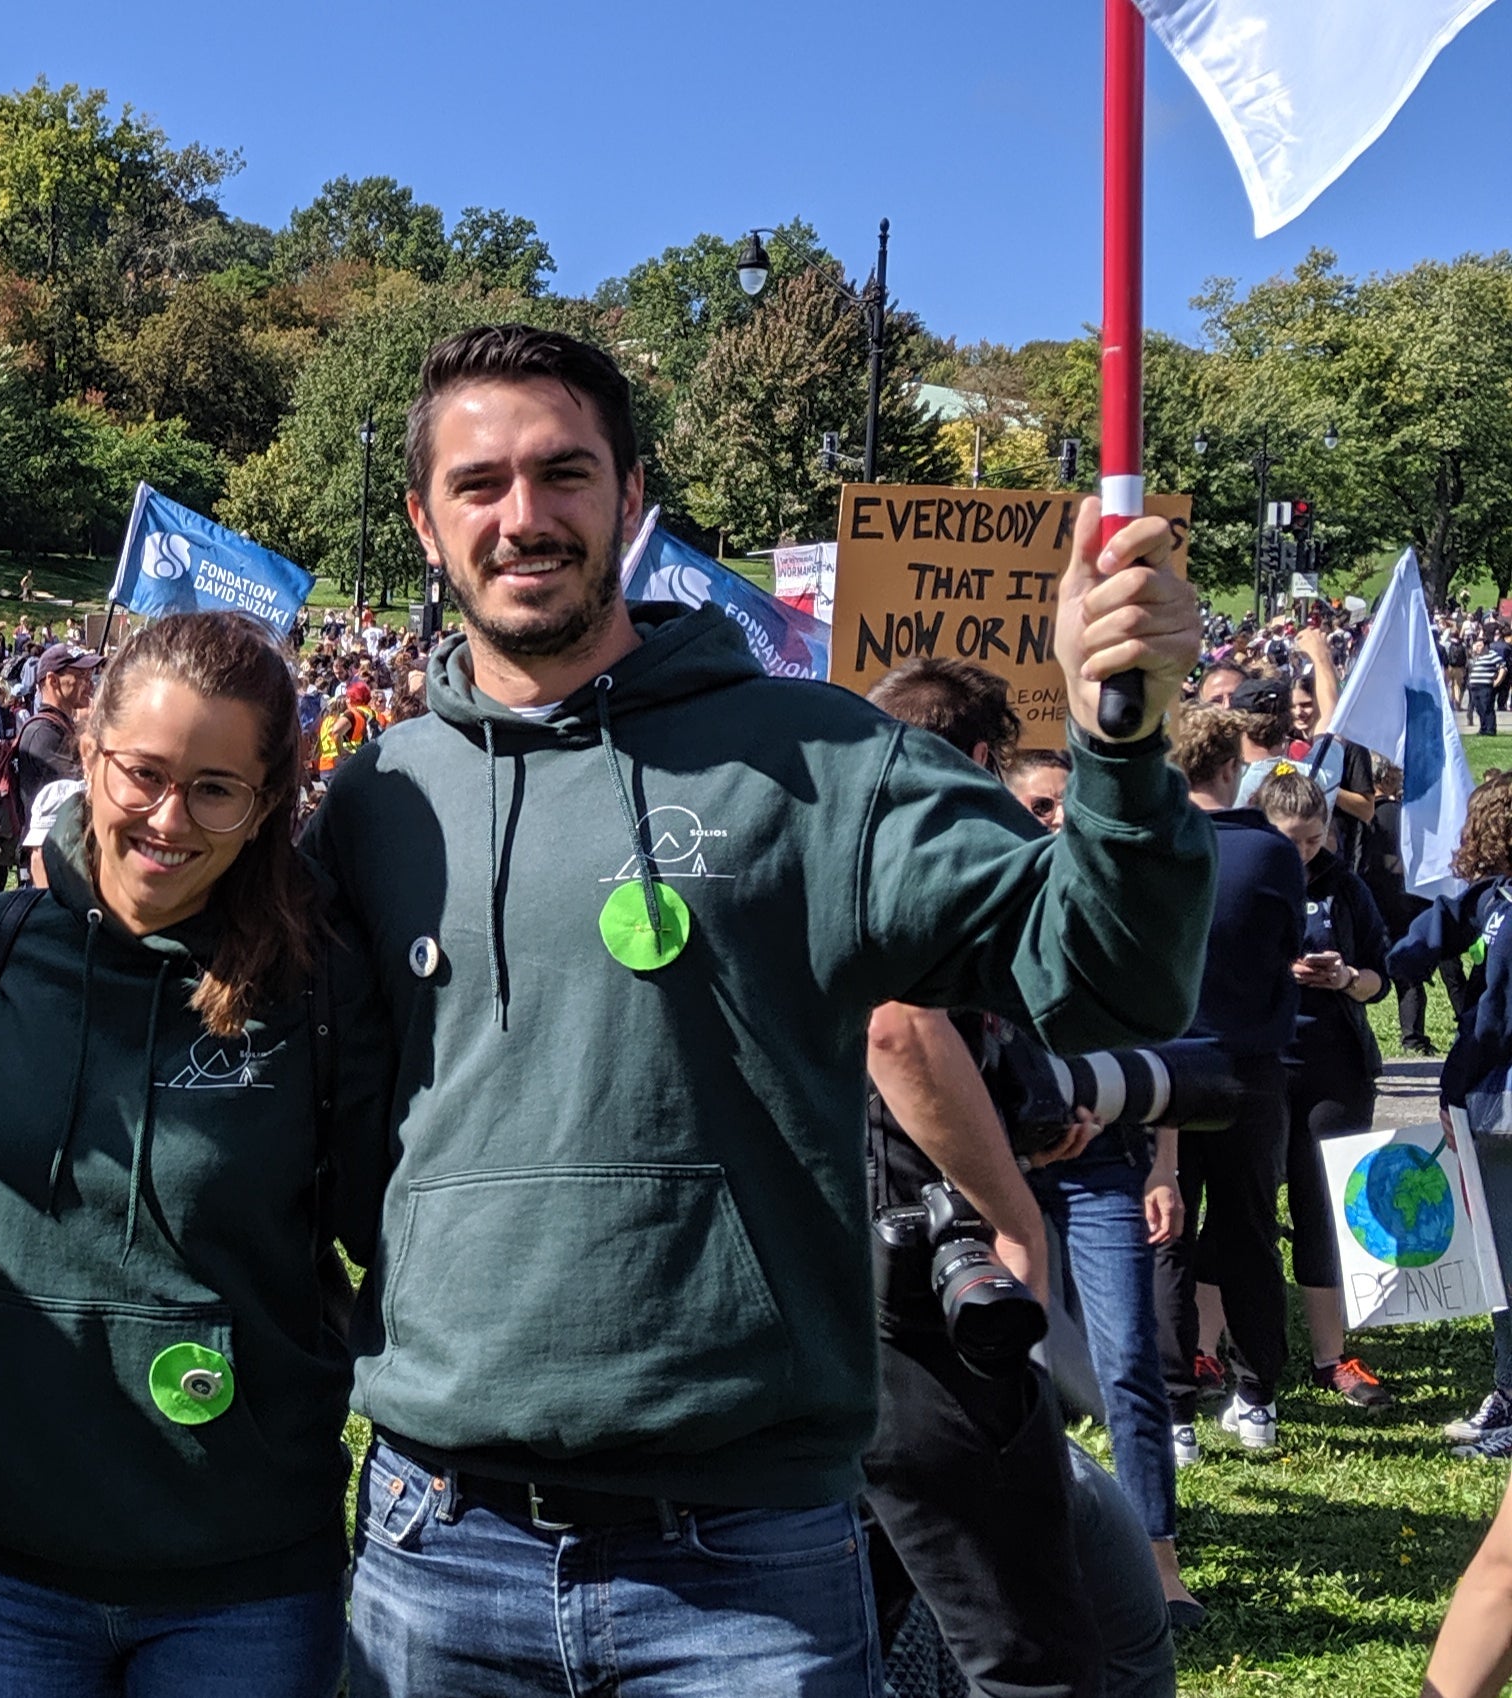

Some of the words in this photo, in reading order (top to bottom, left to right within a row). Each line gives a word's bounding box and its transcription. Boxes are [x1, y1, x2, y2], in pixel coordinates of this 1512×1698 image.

[851, 496, 1053, 548] EVERYBODY
[193, 576, 236, 603] DAVID
[236, 593, 290, 626] SUZUKI
[199, 559, 278, 604] FONDATION
[908, 562, 994, 600] THAT
[1006, 570, 1059, 603] IT
[725, 602, 818, 680] FONDATION
[855, 610, 945, 672] NOW
[956, 615, 1010, 660] OR
[1012, 706, 1067, 722] OHE
[689, 829, 728, 837] SOLIOS
